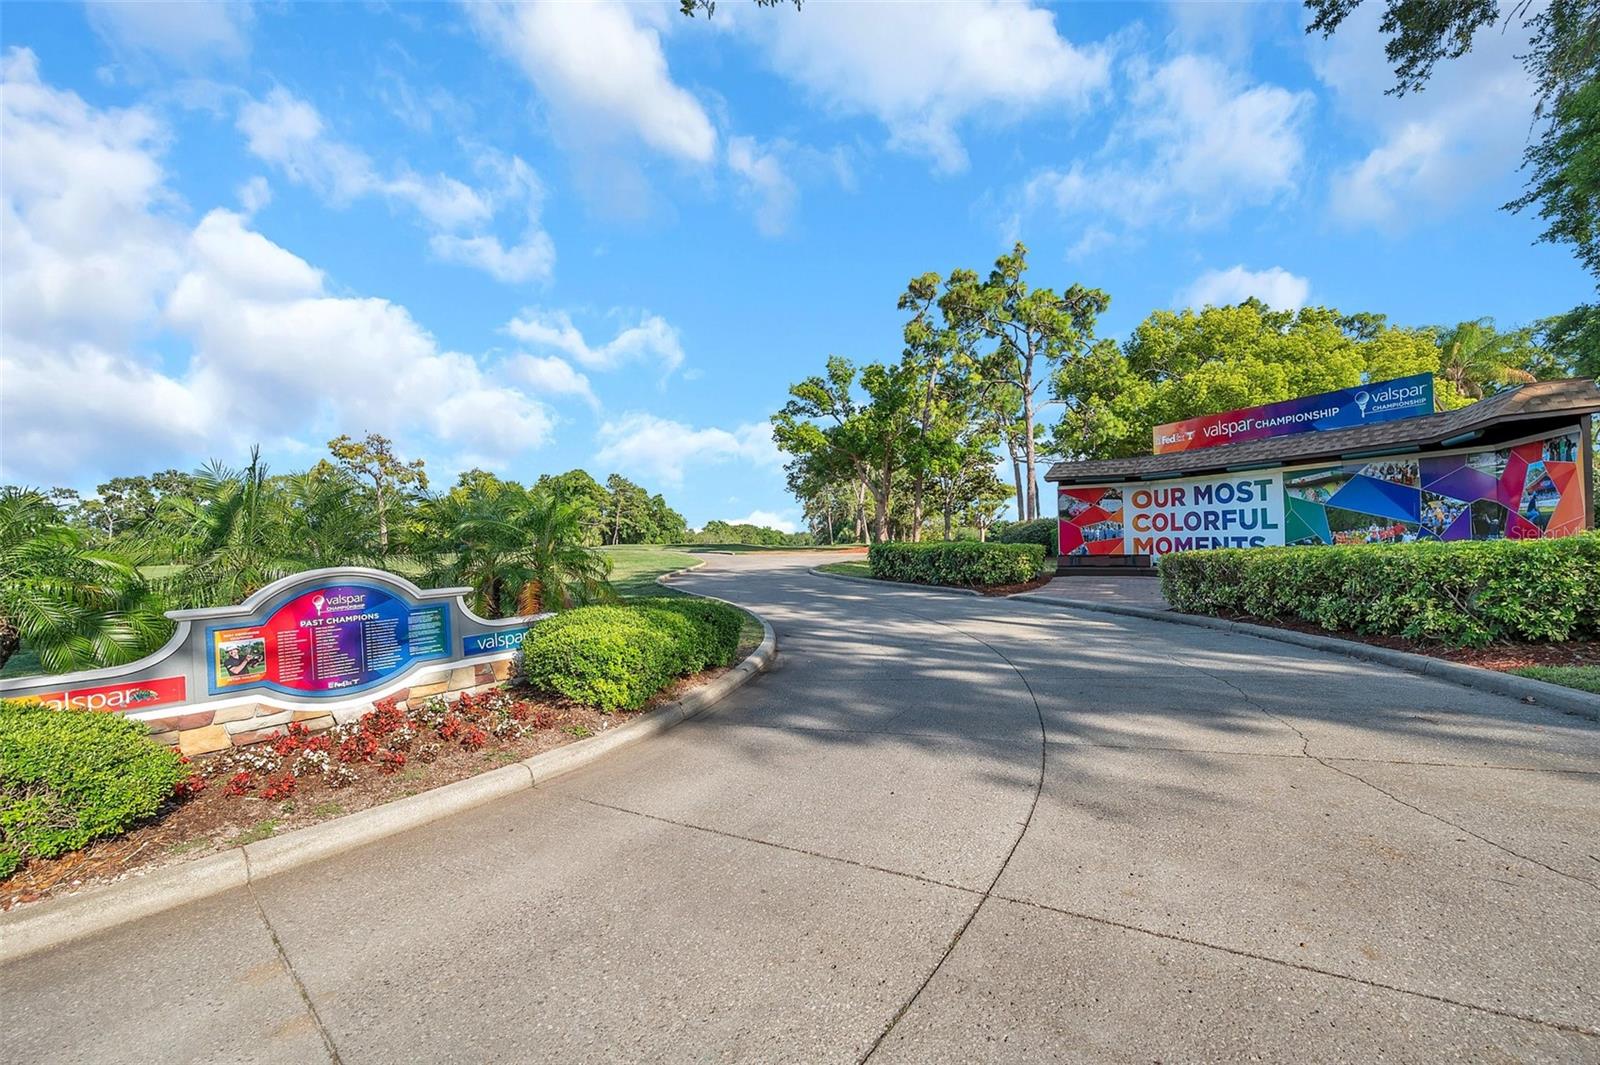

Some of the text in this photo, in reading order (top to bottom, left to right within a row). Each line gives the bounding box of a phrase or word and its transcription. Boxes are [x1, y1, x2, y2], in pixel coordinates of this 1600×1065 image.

[1372, 384, 1428, 404] valspar
[1372, 398, 1427, 411] CHAMPIONSHIP
[1203, 419, 1254, 438] valspar
[1255, 407, 1340, 430] CHAMPIONSHIP
[1131, 479, 1273, 509] OUR MOST
[1132, 507, 1278, 533] COLORFUL
[1132, 535, 1266, 556] MOMENTS
[326, 594, 366, 606] valspar
[299, 612, 380, 628] PAST CHAMPIONS
[477, 632, 528, 650] valspar
[39, 688, 140, 712] alspar
